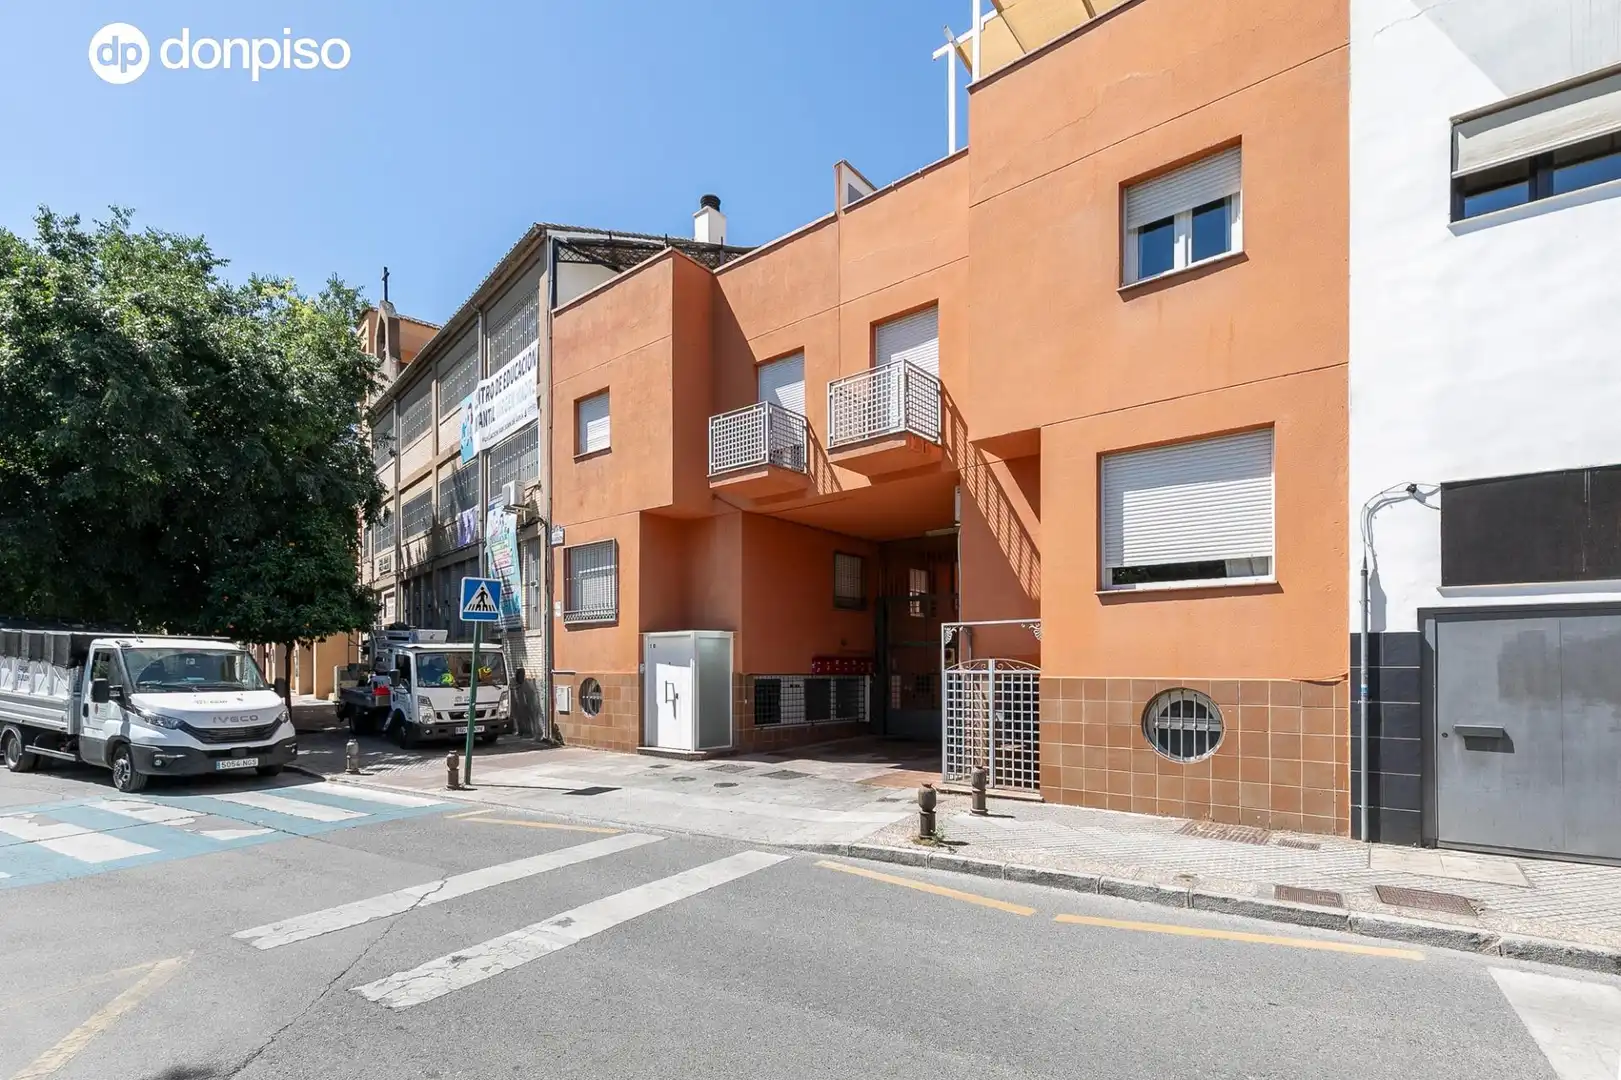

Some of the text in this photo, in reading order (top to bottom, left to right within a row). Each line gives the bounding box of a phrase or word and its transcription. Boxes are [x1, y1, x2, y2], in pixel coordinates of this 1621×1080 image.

[495, 375, 503, 396] DE
[503, 346, 537, 390] EDUCACIÓN
[212, 714, 259, 724] IVECO
